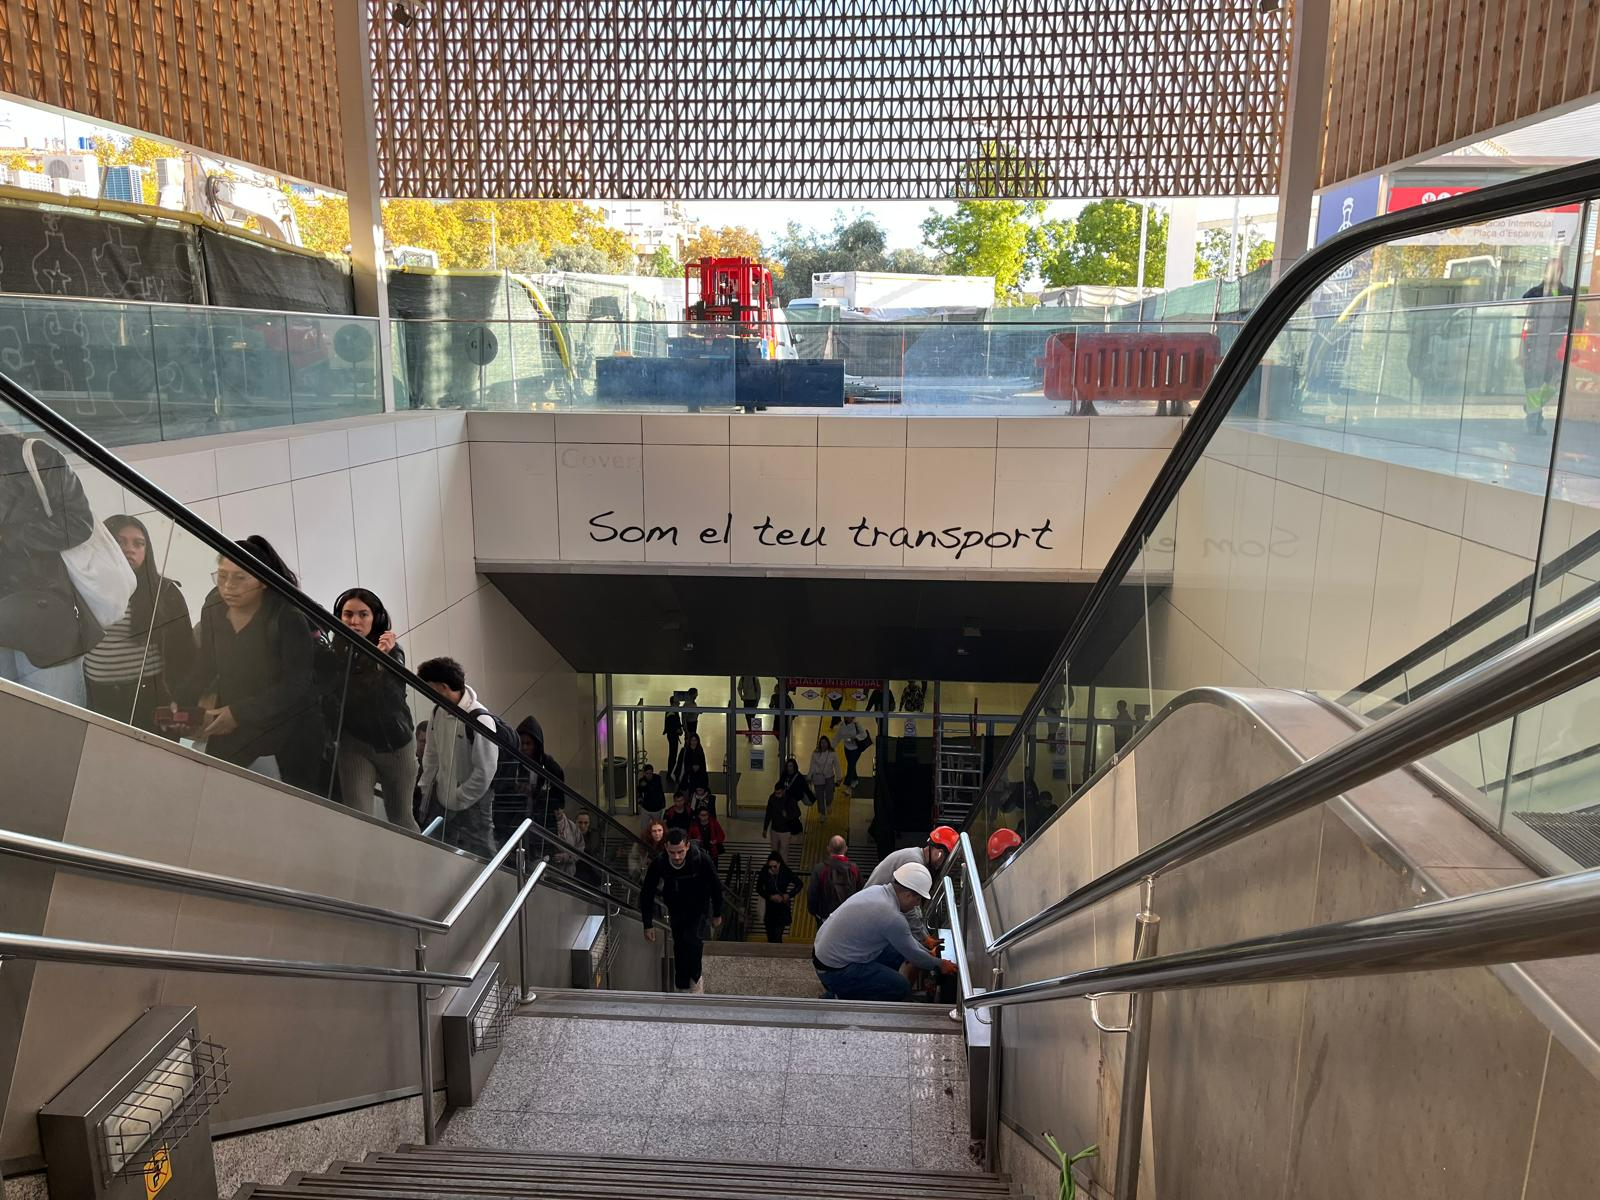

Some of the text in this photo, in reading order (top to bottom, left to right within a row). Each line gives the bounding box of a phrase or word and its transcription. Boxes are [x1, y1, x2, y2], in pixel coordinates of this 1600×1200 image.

[1473, 228, 1495, 239] Plaça
[588, 510, 1055, 560] Som el teu transport
